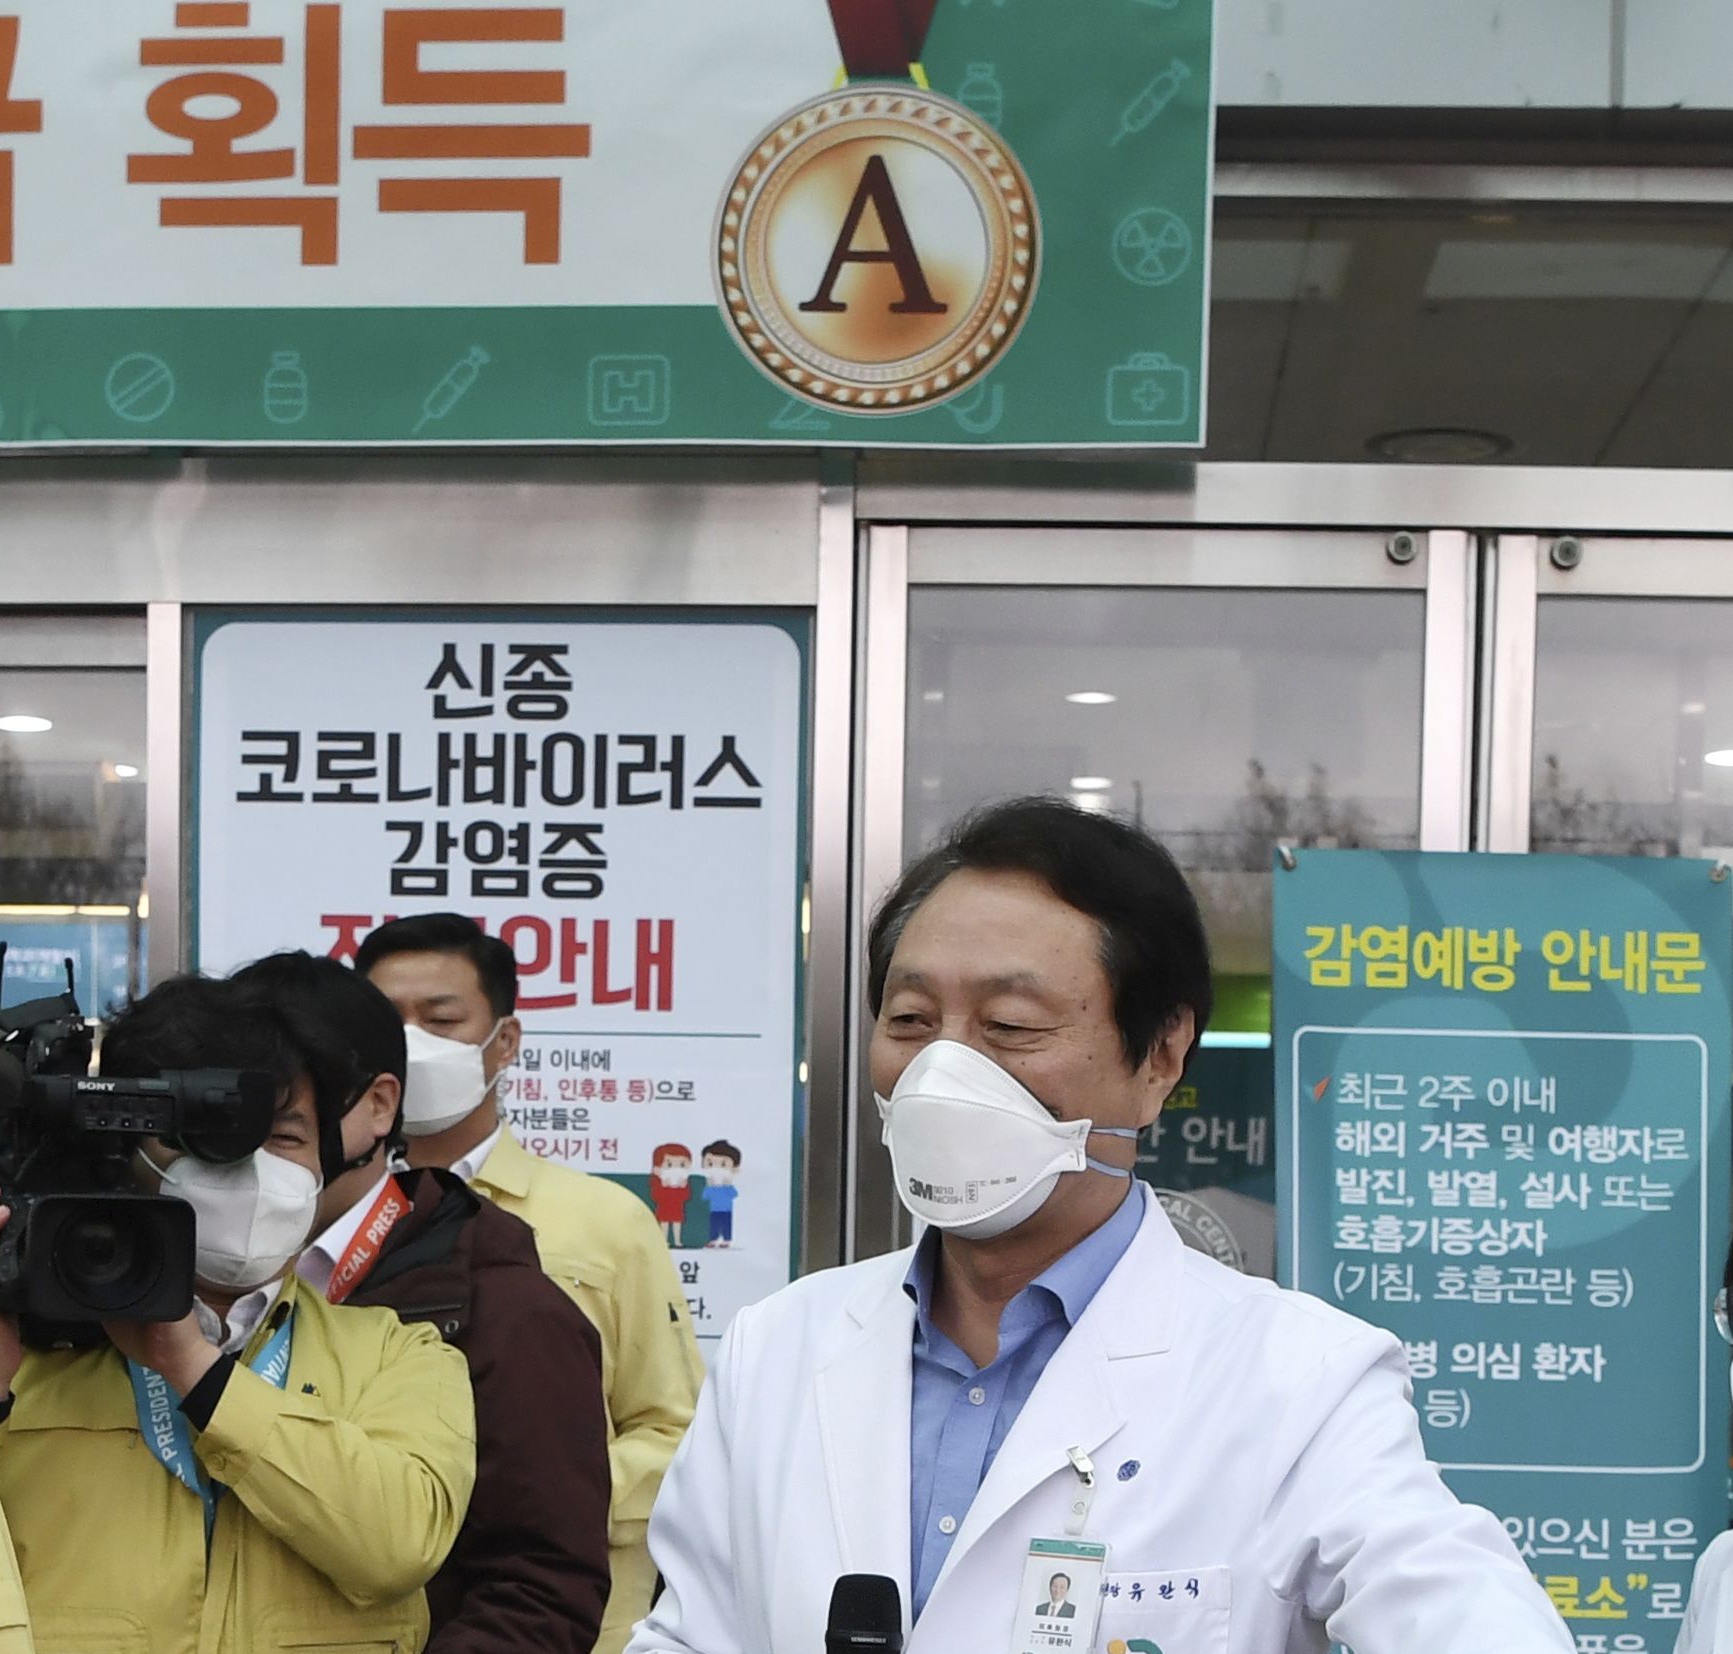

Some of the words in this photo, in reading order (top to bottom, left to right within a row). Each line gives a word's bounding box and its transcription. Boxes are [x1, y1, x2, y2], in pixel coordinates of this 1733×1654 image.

[124, 0, 592, 267] 획득
[797, 153, 949, 316] A
[424, 641, 573, 721] 신종
[236, 730, 763, 810] 코로나바이러스
[384, 819, 609, 899] 감염증
[318, 912, 676, 1012] 안내
[1304, 923, 1522, 991] 감염예방
[1541, 929, 1707, 995] 안내문
[550, 1049, 611, 1071] 이내에
[77, 1080, 116, 1092] SONY
[558, 1079, 618, 1102] 인후통
[627, 1080, 696, 1103] 등)으로
[1337, 1072, 1408, 1112] 최근
[1418, 1075, 1476, 1114] 2주
[1488, 1075, 1557, 1115] 이내
[503, 1107, 590, 1131] 자분들은
[1182, 1117, 1267, 1166] 안내
[523, 1137, 590, 1160] 오시기
[598, 1138, 619, 1161] 전
[1334, 1120, 1406, 1159] 해외
[1419, 1121, 1490, 1160] 거주
[1501, 1122, 1536, 1163] 및
[1548, 1124, 1689, 1166] 여행자로
[909, 1177, 933, 1201] 3M
[1334, 1168, 1415, 1208] 발진,
[1427, 1169, 1508, 1209] 발열,
[1520, 1170, 1590, 1211] 설사
[1601, 1173, 1675, 1213] 또는
[366, 1198, 401, 1246] PRESS
[1334, 1214, 1547, 1257] 호흡기증상자
[1333, 1261, 1422, 1304] (기침,
[1434, 1263, 1576, 1307] 호흡곤란
[1586, 1266, 1634, 1308] 등)
[1452, 1341, 1522, 1381] 의심
[1531, 1343, 1606, 1384] 환자
[1501, 1516, 1611, 1560] 있으신
[1621, 1518, 1698, 1561] 분은
